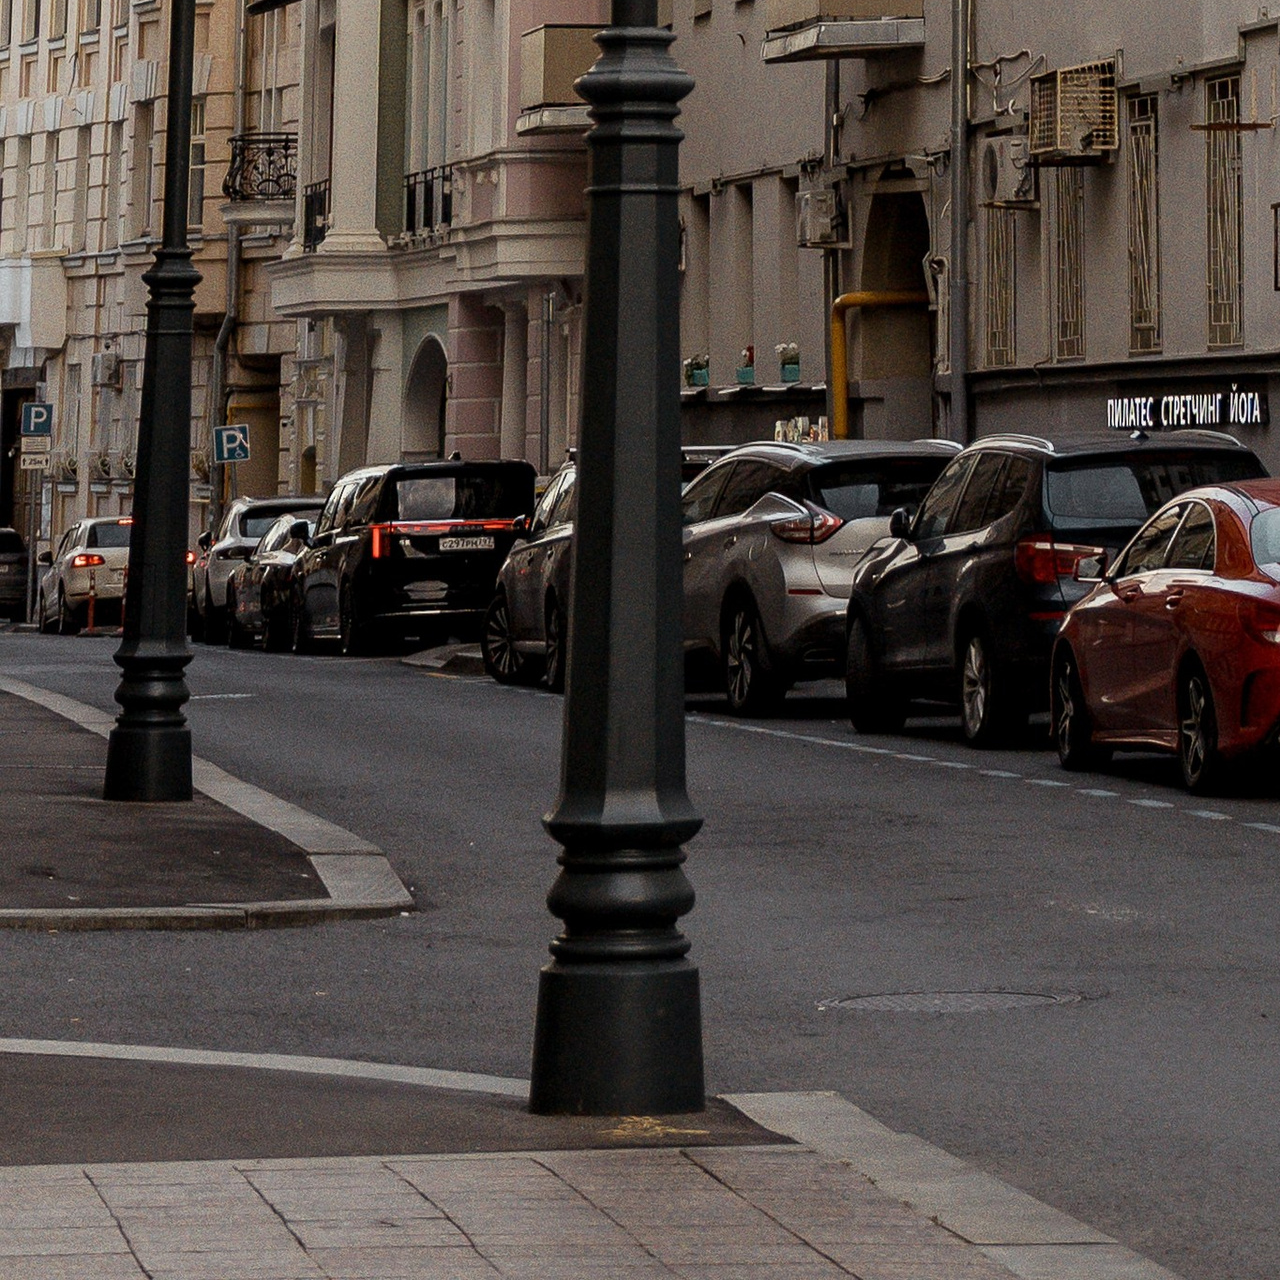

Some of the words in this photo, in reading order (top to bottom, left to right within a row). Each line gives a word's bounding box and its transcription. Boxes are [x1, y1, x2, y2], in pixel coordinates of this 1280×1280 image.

[30, 407, 48, 431] P
[1107, 396, 1154, 428] ПИЛАТЕС
[1160, 393, 1222, 427] СТРЕТЧИНГ
[1229, 383, 1261, 424] ЙОГА
[222, 430, 242, 458] P
